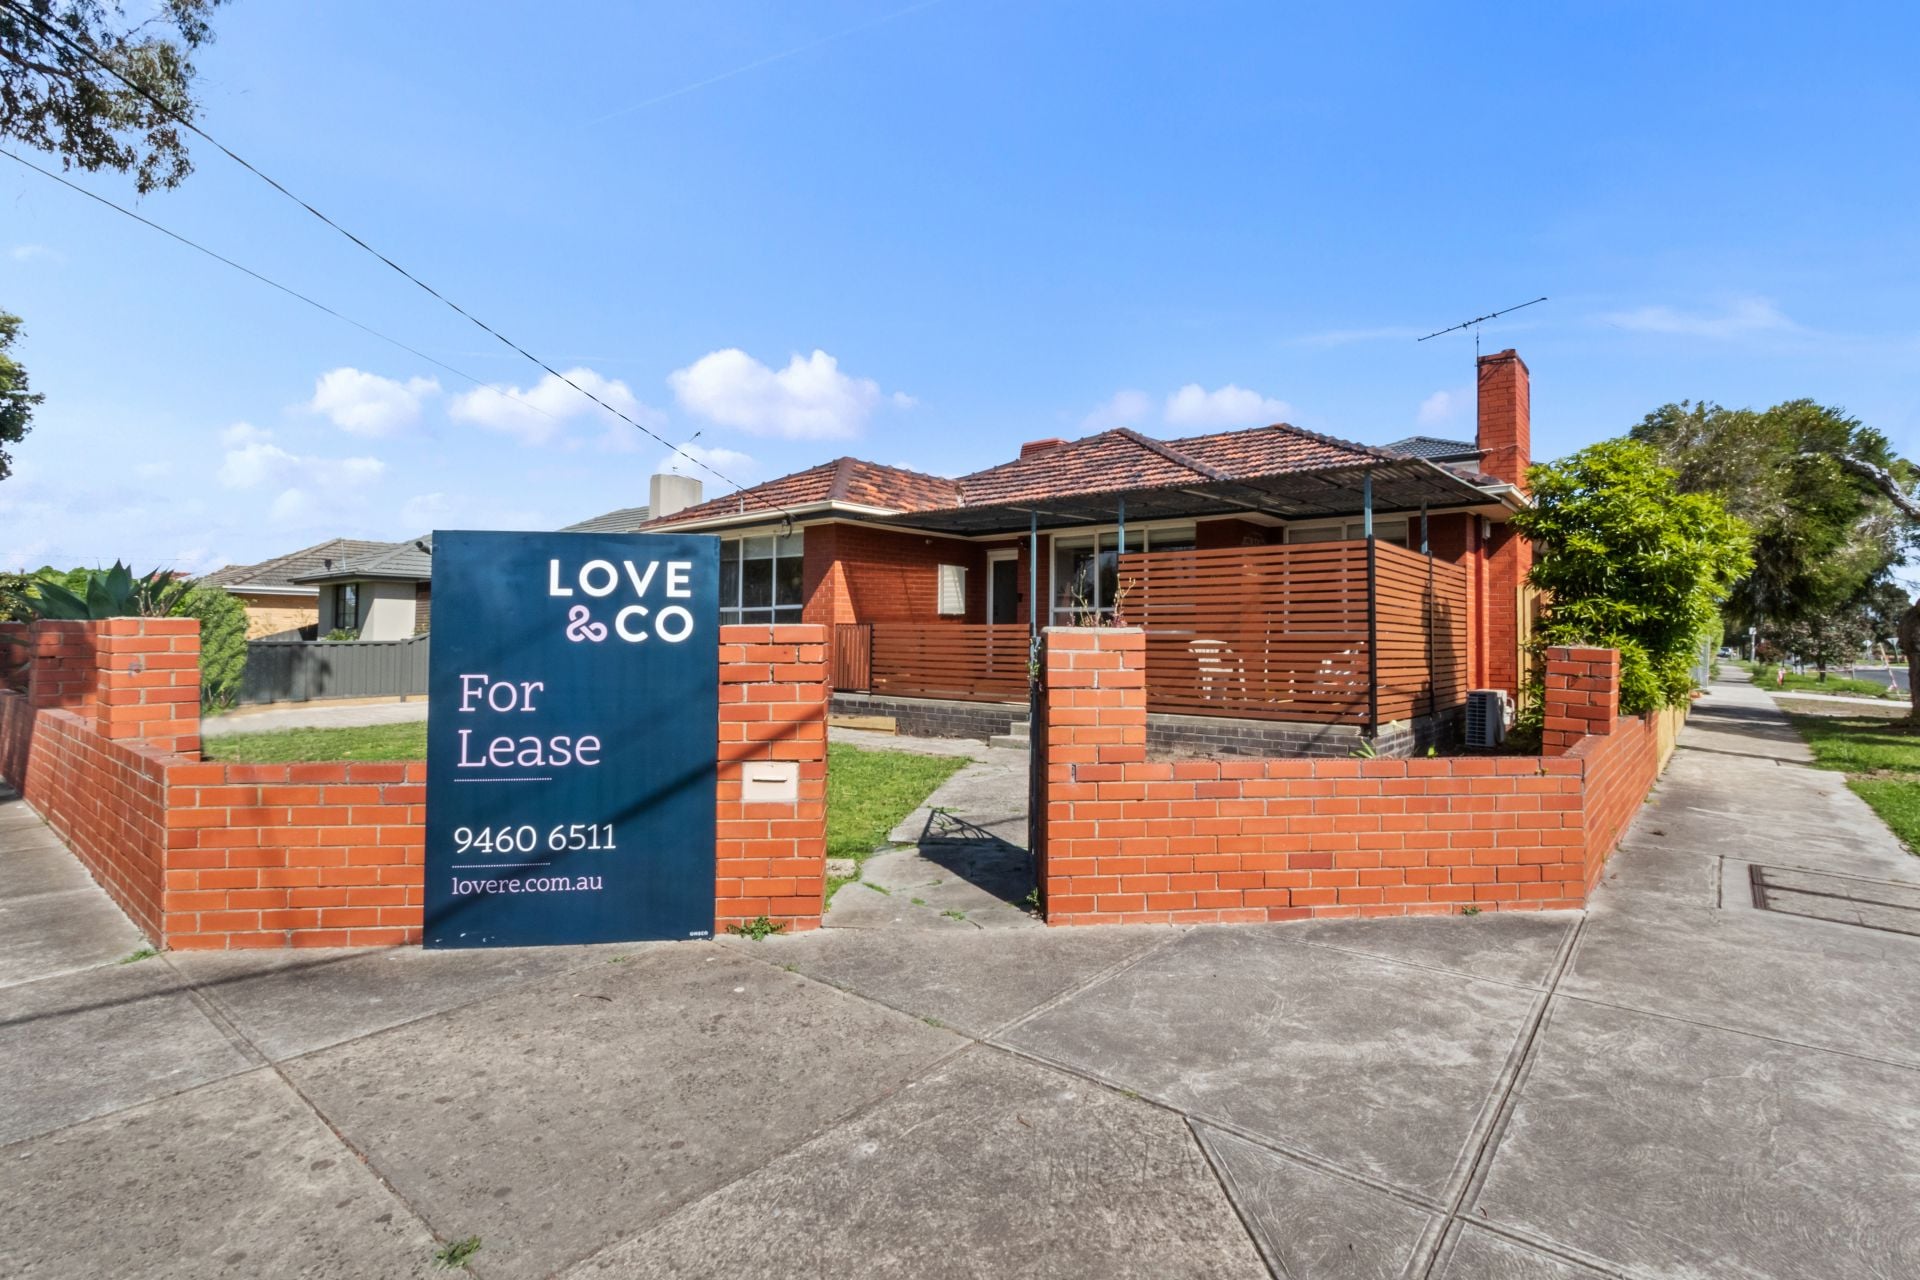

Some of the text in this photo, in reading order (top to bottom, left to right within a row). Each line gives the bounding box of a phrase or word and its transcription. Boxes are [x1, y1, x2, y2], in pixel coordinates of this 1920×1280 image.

[549, 559, 692, 598] LOVE
[458, 673, 544, 712] For
[457, 729, 601, 767] Lease
[453, 823, 617, 854] 9460 6511
[451, 876, 603, 895] lovere.com.au
